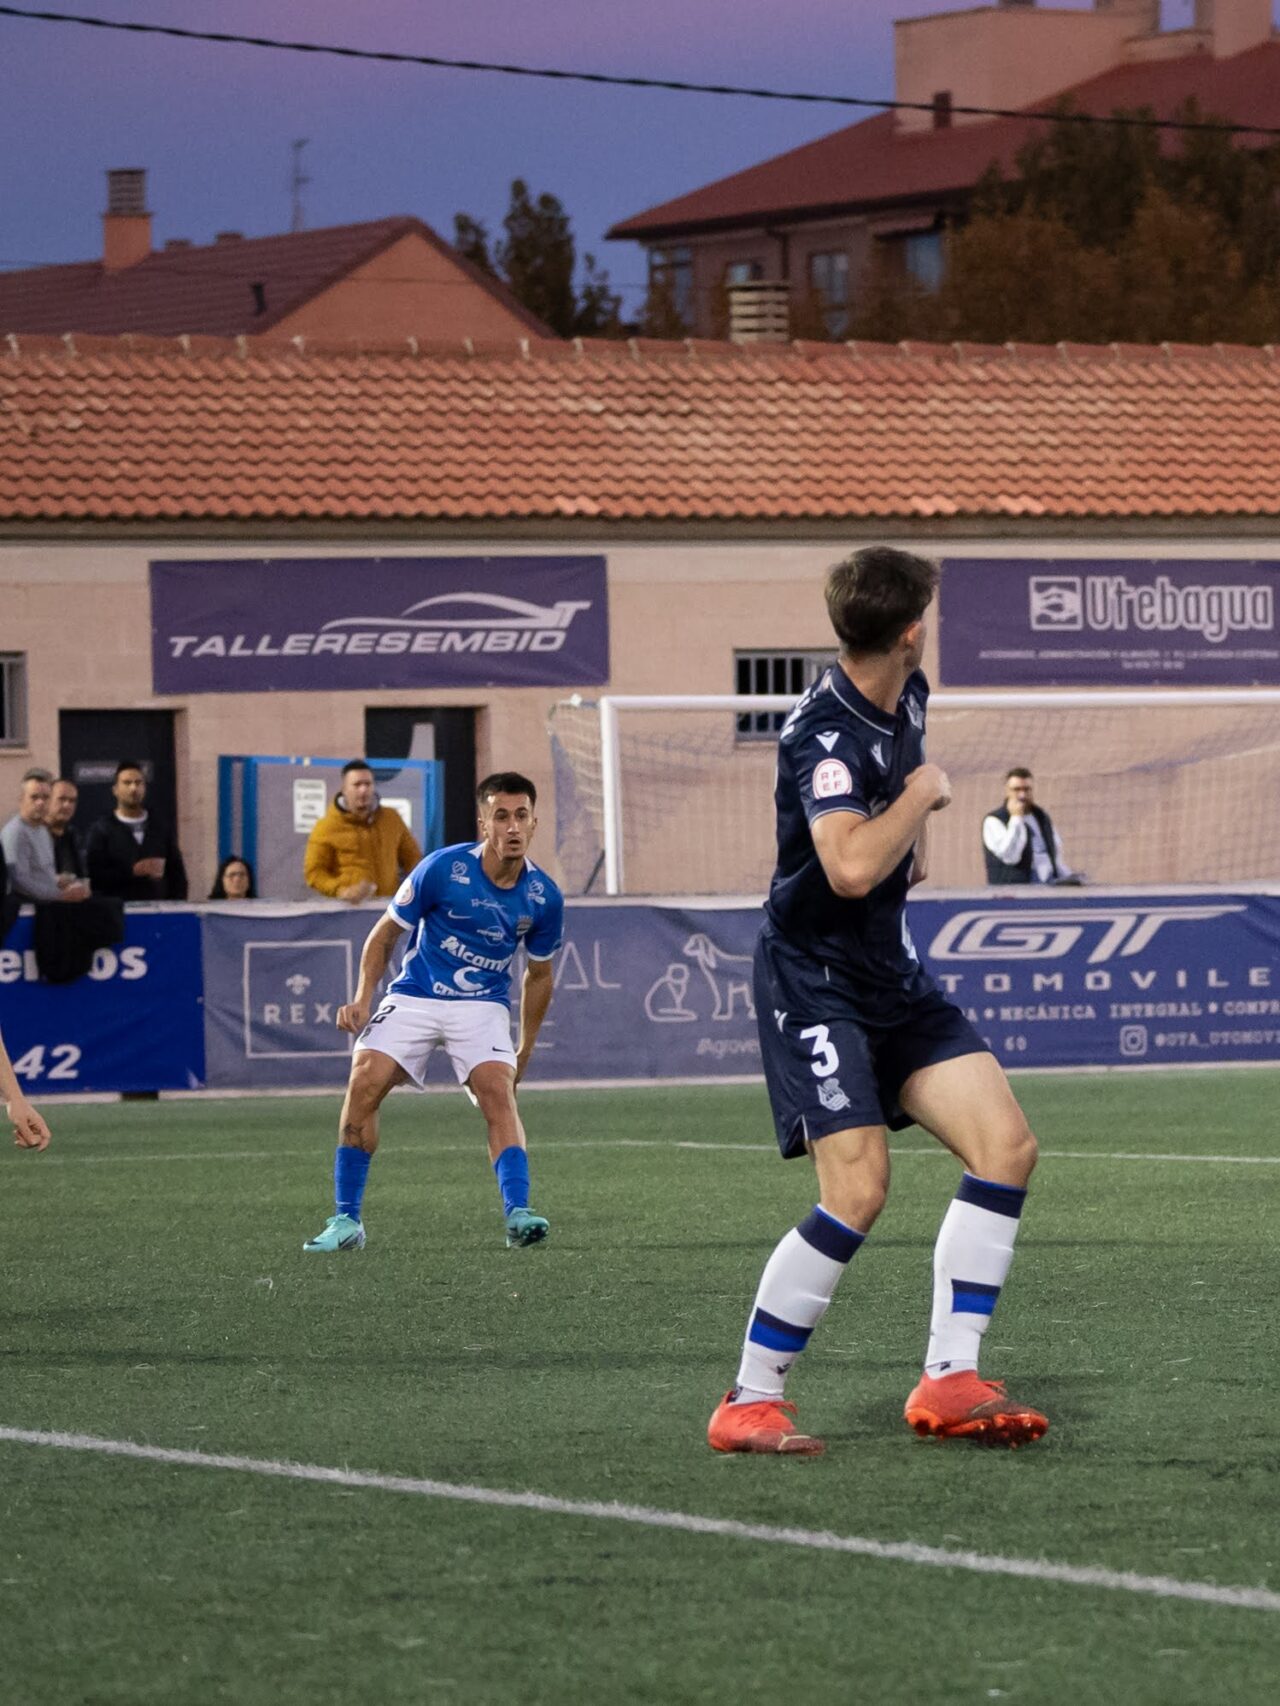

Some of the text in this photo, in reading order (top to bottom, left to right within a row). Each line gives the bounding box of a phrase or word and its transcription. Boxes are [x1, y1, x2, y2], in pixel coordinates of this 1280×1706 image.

[1086, 575, 1274, 643] Utebagua
[263, 1003, 332, 1025] REX
[1110, 1002, 1202, 1019] INTEGRAL
[13, 1044, 82, 1080] 42
[800, 1024, 840, 1078] 3
